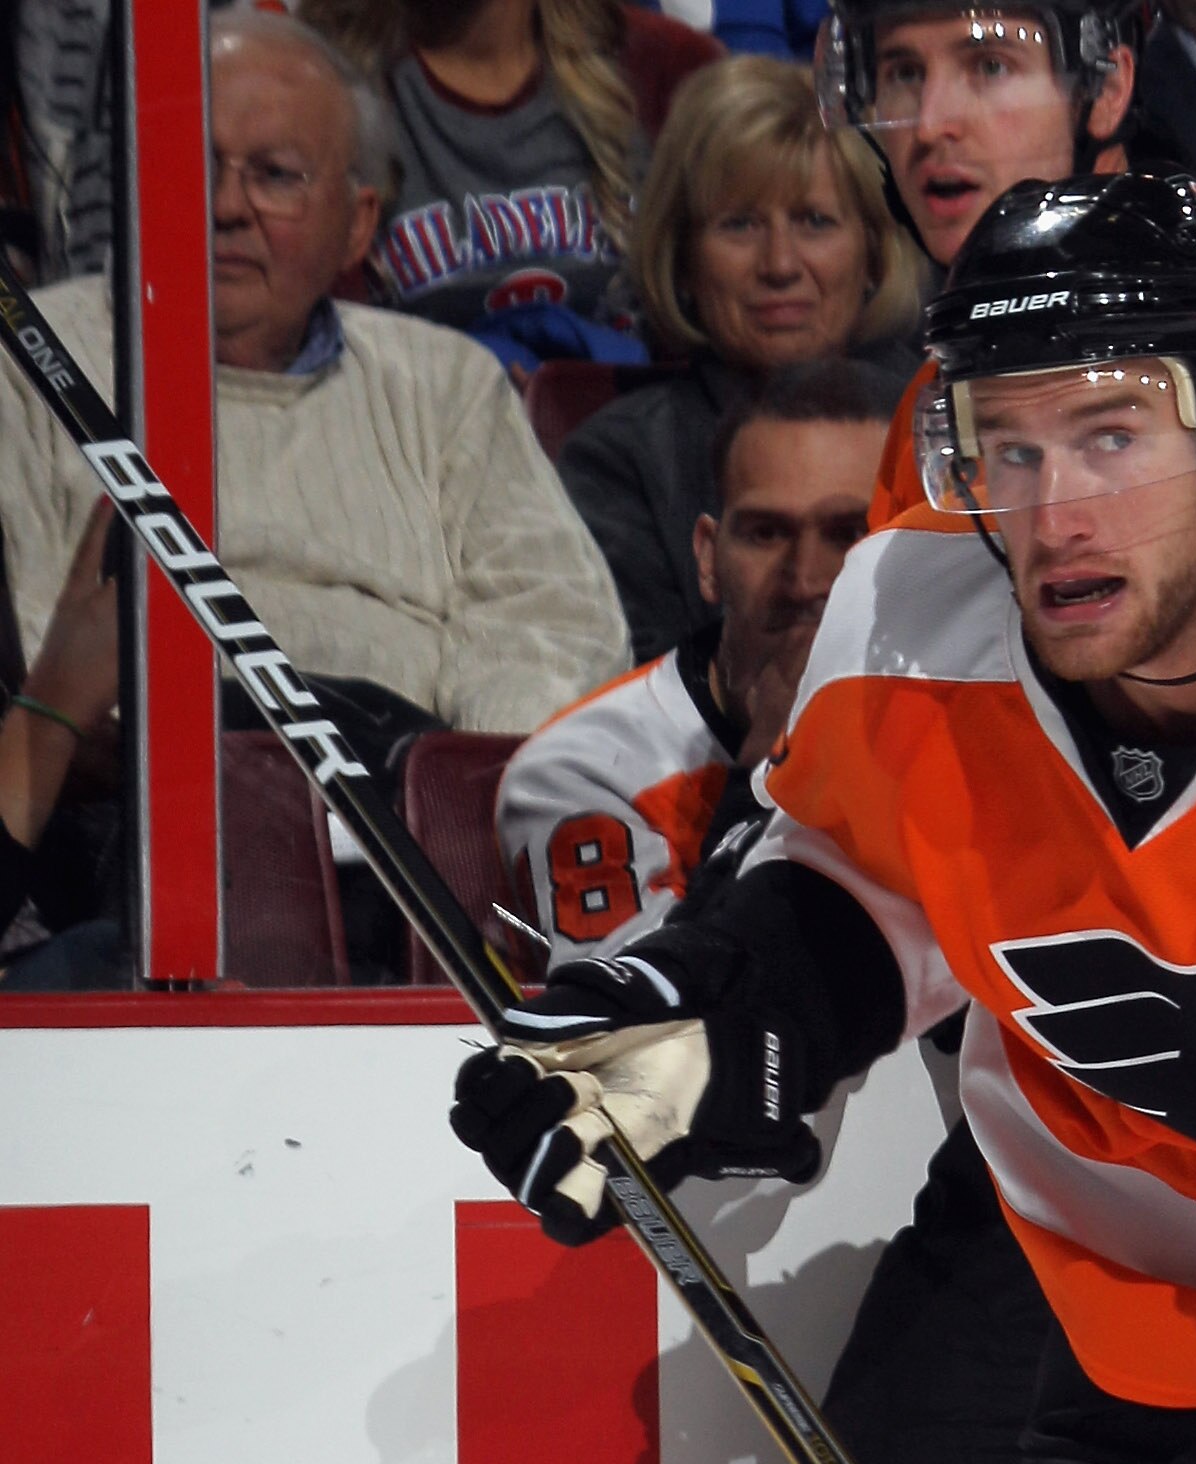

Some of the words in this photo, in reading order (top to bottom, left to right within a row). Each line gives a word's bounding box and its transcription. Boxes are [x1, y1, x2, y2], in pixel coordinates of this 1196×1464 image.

[970, 290, 1071, 320] BAUER
[17, 326, 75, 392] ONE
[83, 439, 371, 785] BAUER
[763, 1030, 781, 1122] BAUER
[607, 1176, 704, 1286] BAUER
